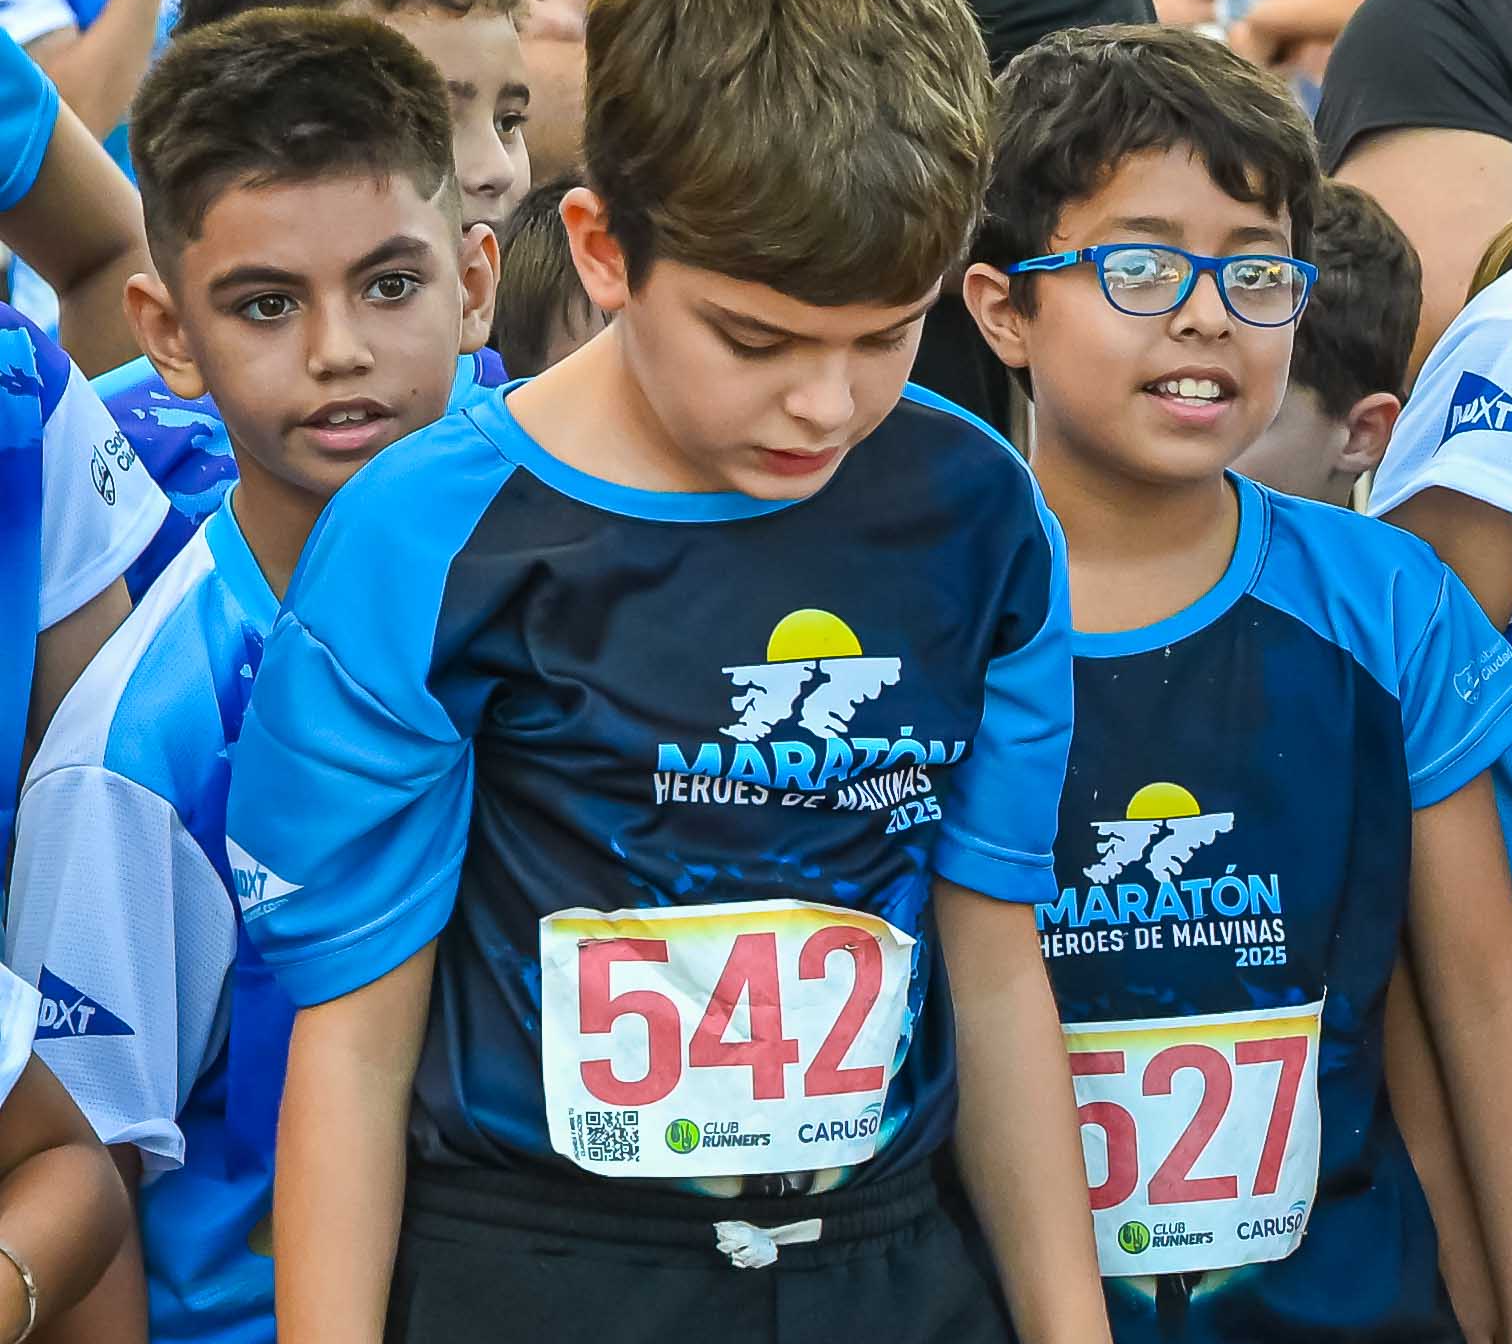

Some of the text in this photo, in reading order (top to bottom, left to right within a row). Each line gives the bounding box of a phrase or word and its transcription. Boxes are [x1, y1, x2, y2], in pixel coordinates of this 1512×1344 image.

[657, 726, 967, 790] MARATÓN
[832, 763, 932, 812] MALVINAS
[885, 796, 942, 834] 2025
[1034, 865, 1283, 932] MARATÓN
[1039, 918, 1286, 959] HÉROES DE MALVINAS
[1235, 946, 1287, 967] 2025
[577, 924, 885, 1107] 542
[702, 1115, 879, 1148] RUNNER'S CARUSO
[703, 1121, 739, 1134] CLUB
[1067, 1035, 1309, 1210] 527
[1152, 1211, 1304, 1248] RUNNER'S CARUSO
[1153, 1222, 1186, 1235] CLUB
